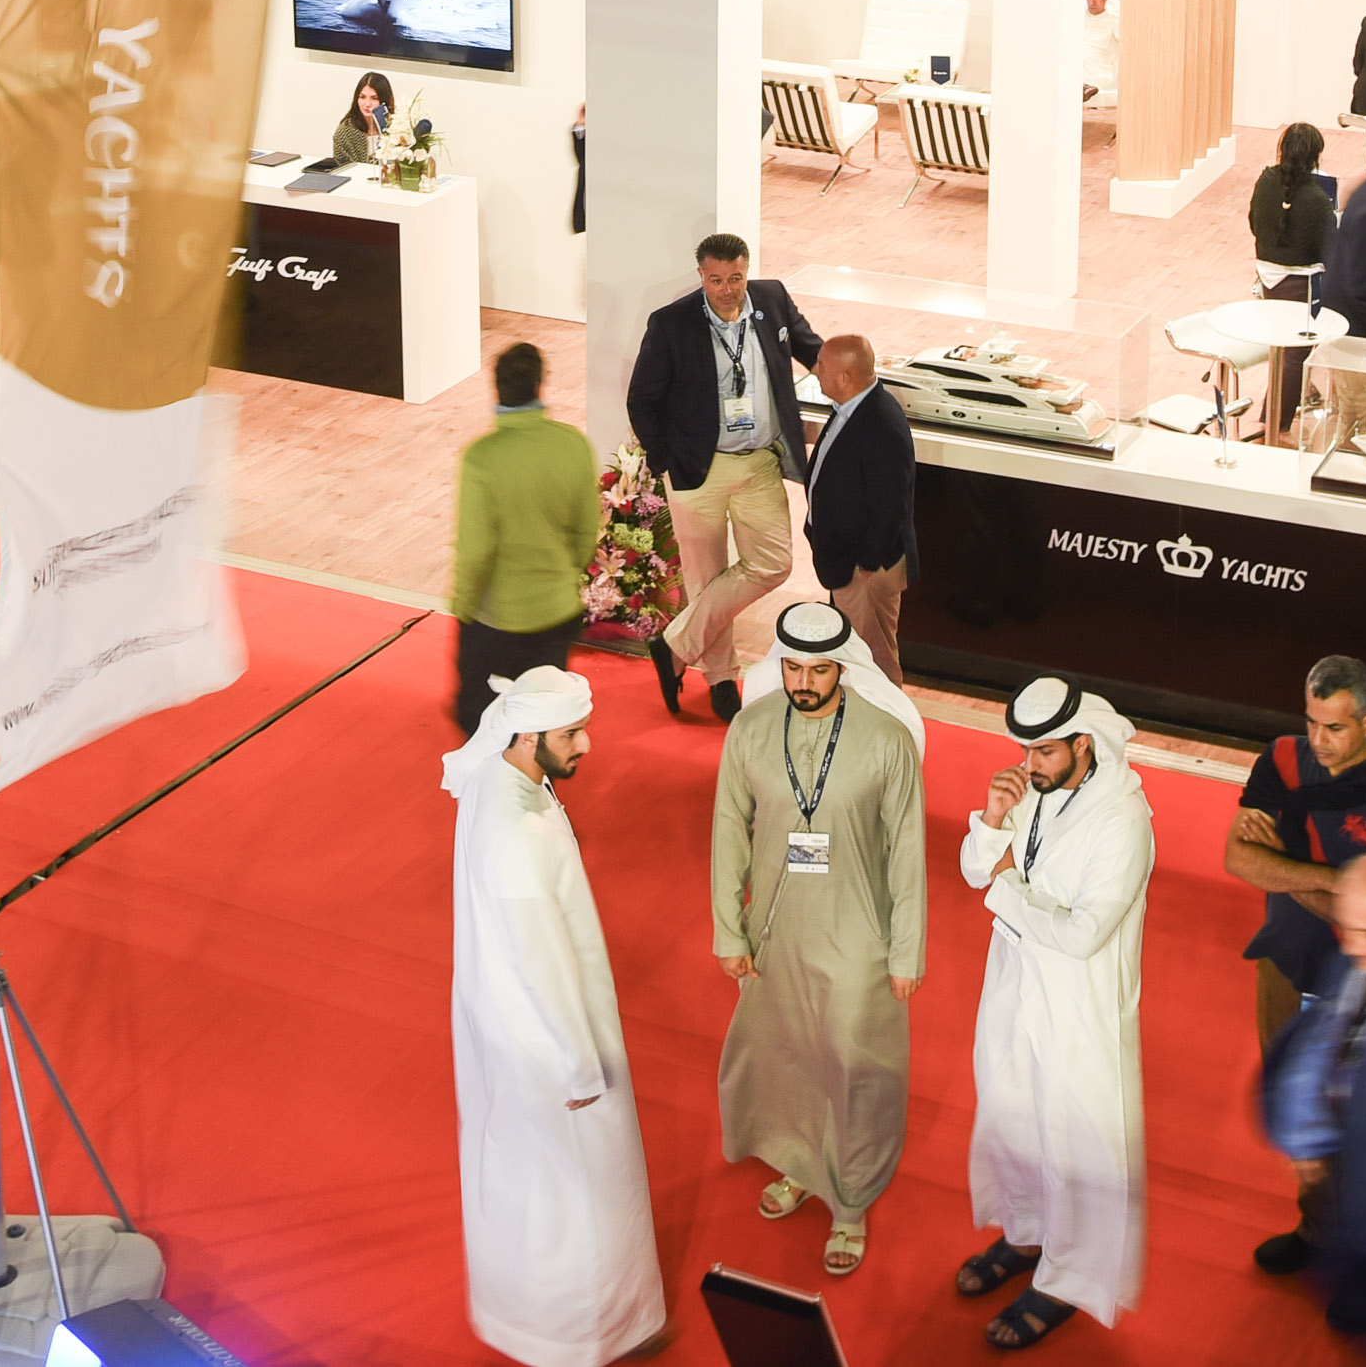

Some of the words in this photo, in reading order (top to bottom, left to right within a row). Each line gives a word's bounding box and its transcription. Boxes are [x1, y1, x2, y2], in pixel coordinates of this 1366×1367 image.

[84, 17, 160, 309] YACHTS
[277, 255, 338, 290] Craft
[1047, 528, 1148, 564] MAJESTY
[1220, 557, 1308, 592] YACHTS
